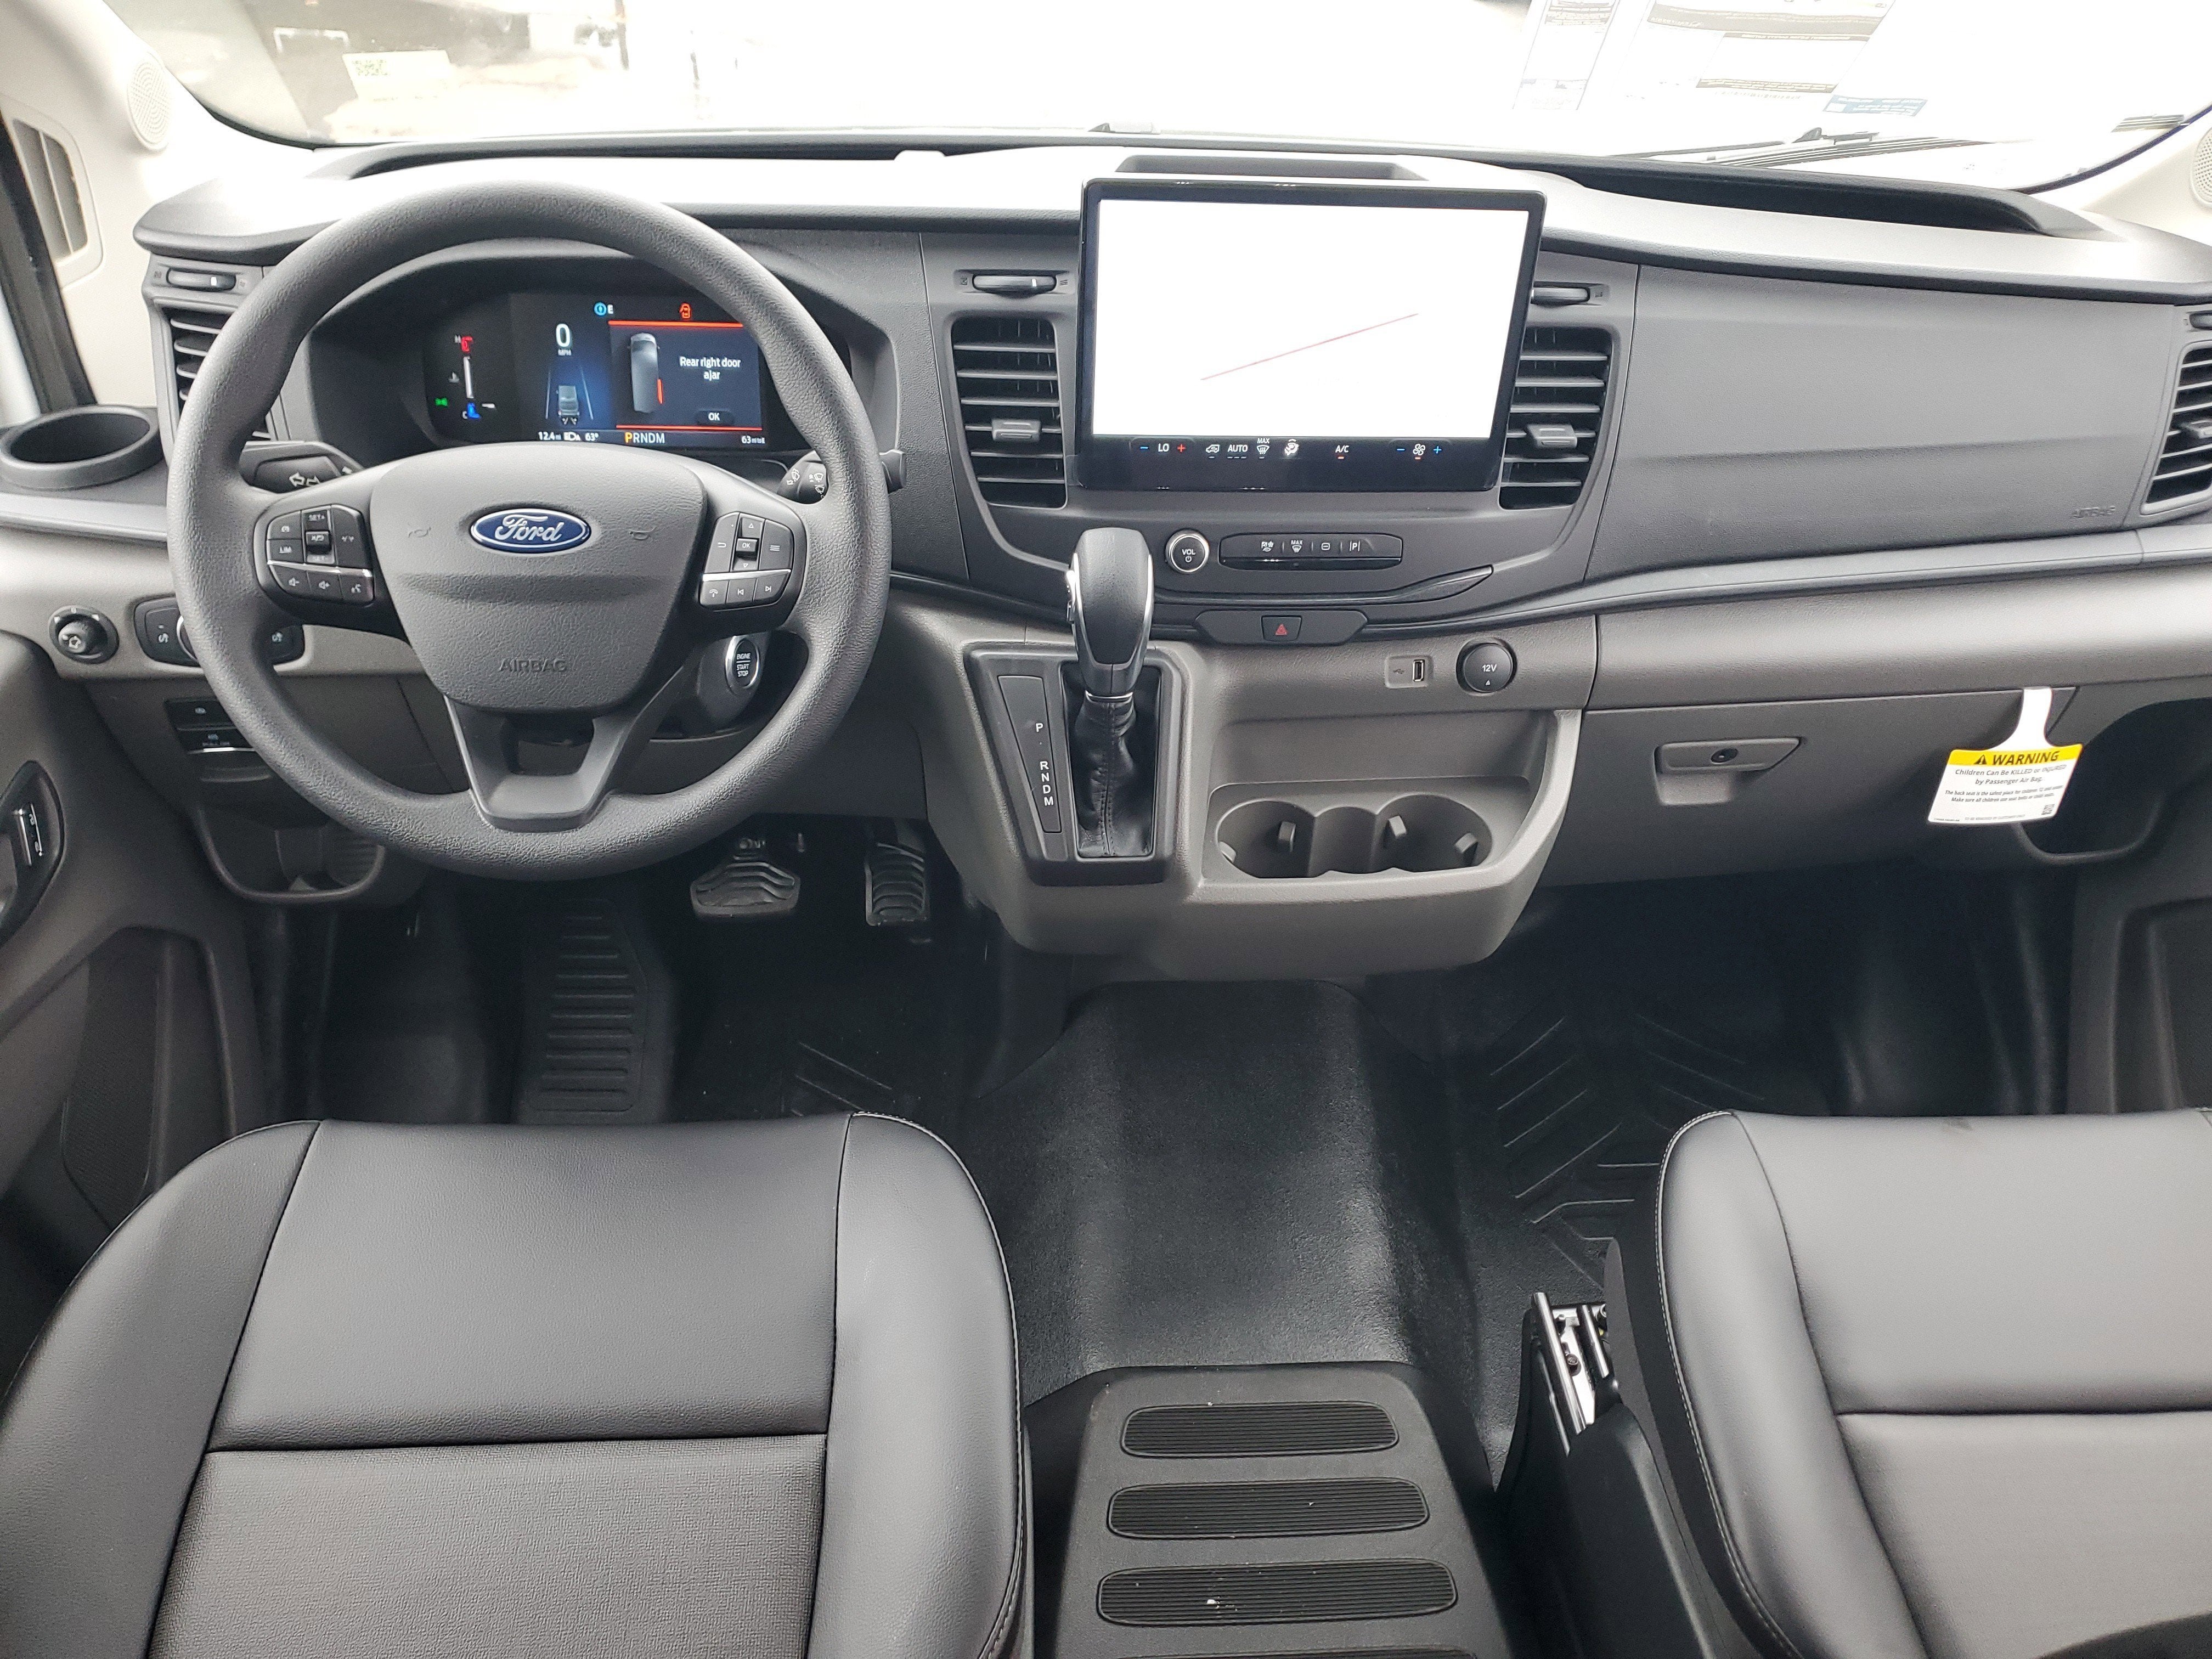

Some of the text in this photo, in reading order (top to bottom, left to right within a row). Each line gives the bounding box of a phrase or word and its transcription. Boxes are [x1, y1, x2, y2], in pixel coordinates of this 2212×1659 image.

[555, 323, 571, 347] 0
[679, 356, 741, 368] Rear right door
[703, 370, 720, 381] ajar
[708, 413, 720, 421] OK
[625, 432, 665, 444] PRNDM
[1158, 443, 1170, 452] LO
[1227, 444, 1248, 453] AUTO
[1335, 445, 1350, 453] A/C
[495, 514, 565, 541] Ford
[499, 658, 567, 672] AIRBAG
[1482, 664, 1497, 673] 12V
[1036, 723, 1043, 732] P
[1991, 751, 2060, 765] WARNING
[1040, 761, 1049, 770] R
[1041, 772, 1050, 782] N
[1042, 785, 1051, 794] D
[1043, 797, 1054, 806] M
